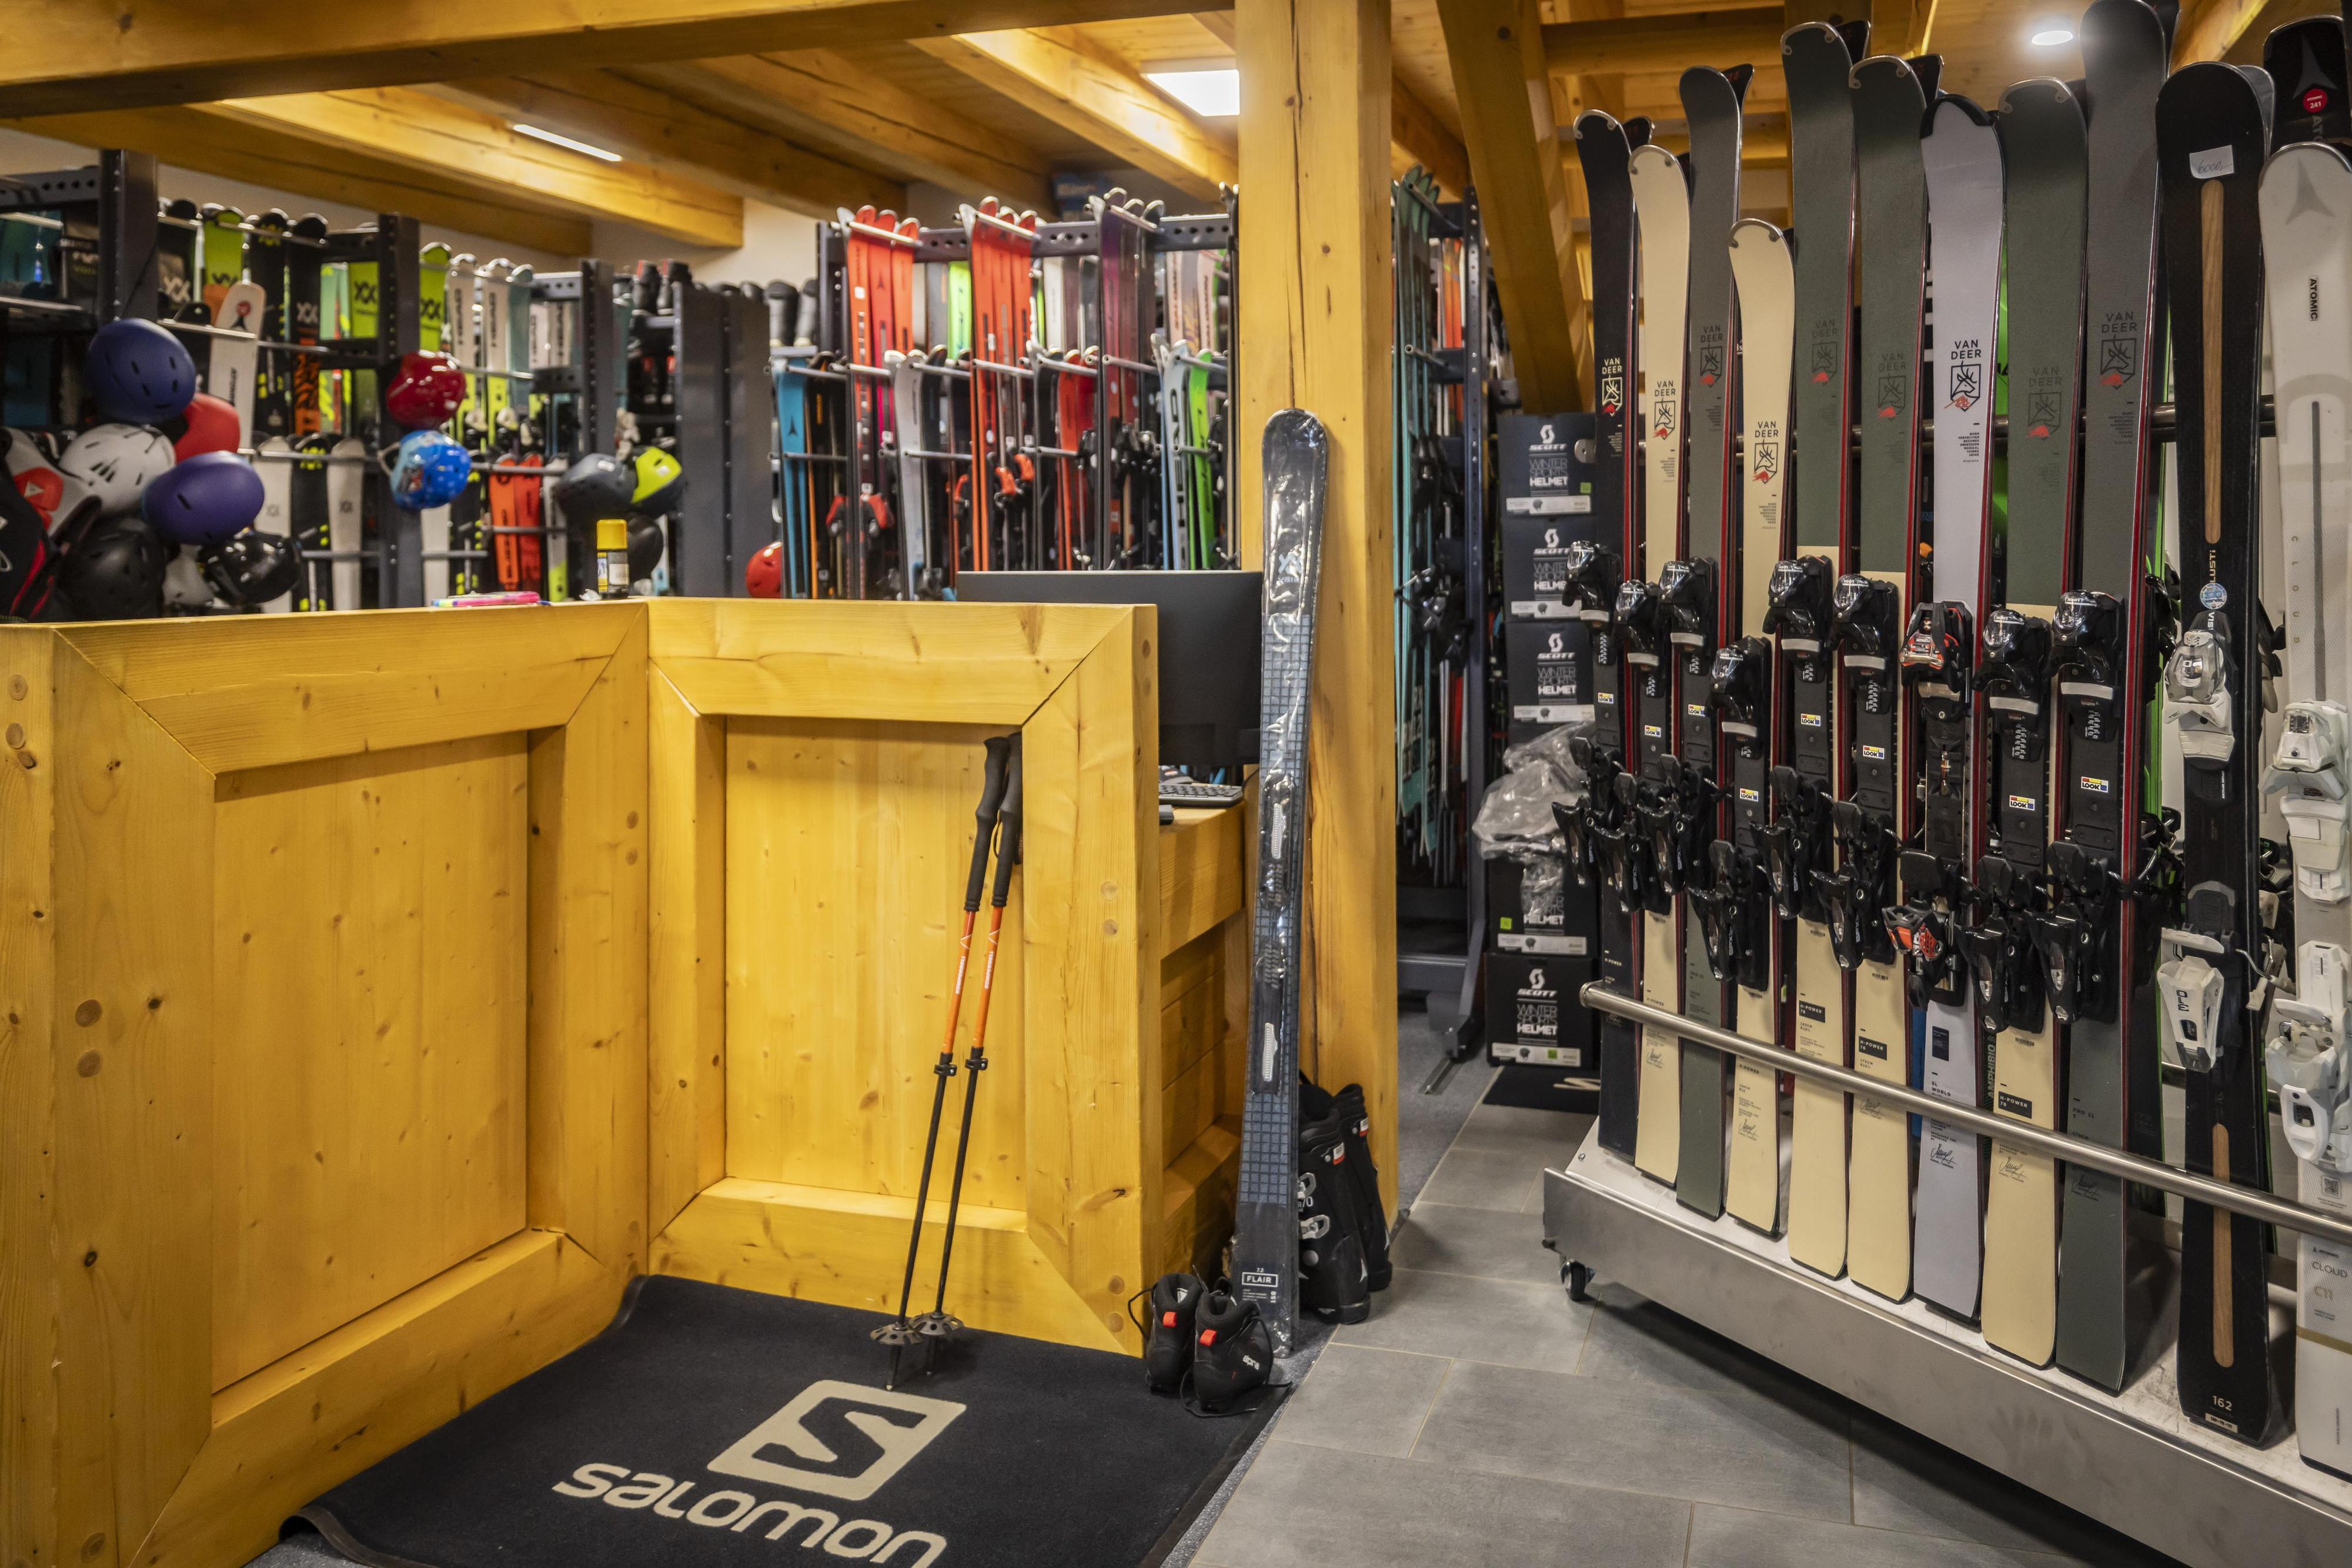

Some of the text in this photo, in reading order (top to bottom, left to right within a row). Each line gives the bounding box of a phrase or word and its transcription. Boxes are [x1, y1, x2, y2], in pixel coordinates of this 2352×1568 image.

[2310, 279, 2318, 319] ATOMIC
[2106, 311, 2134, 322] VAN
[1703, 325, 1720, 333] VAN
[2102, 322, 2137, 333] DEER
[1700, 334, 1723, 343] DEER
[1955, 339, 1978, 349] VAN
[1951, 349, 1982, 360] DEER
[1604, 357, 1620, 366] VAN
[1602, 366, 1622, 374] DEER
[1655, 388, 1676, 397] DEER
[1755, 430, 1779, 438] DEER
[1529, 458, 1568, 469] WINTER
[1530, 469, 1568, 477] SPORTS
[1530, 477, 1568, 486] HELMET
[1534, 563, 1566, 572] WINTE
[1534, 572, 1566, 580] SPORT
[1534, 580, 1566, 590] HELME
[1538, 667, 1576, 677] WINTER
[1538, 677, 1576, 685] SPORTS
[1538, 685, 1576, 695] HELMET
[1524, 915, 1564, 924] HELMET
[955, 955, 965, 994] KOMPERDELL
[984, 951, 994, 989] KOMPERDELL
[1516, 988, 1557, 997] SCOTT
[1517, 1005, 1557, 1015] WINTER
[1800, 1004, 1822, 1014] H-POWER
[1517, 1015, 1557, 1024] SPORTS
[1517, 1024, 1558, 1035] HELMET
[1860, 1040, 1883, 1051] H-POWER
[1739, 1064, 1759, 1074] H-POWER
[1932, 1087, 1952, 1096] WORLD
[2000, 1096, 2027, 1108] H-POWER
[2312, 1261, 2348, 1278] CLOUD
[1242, 1355, 1259, 1370] alpina
[2213, 1396, 2232, 1411] 162
[552, 1462, 948, 1568] salomon
